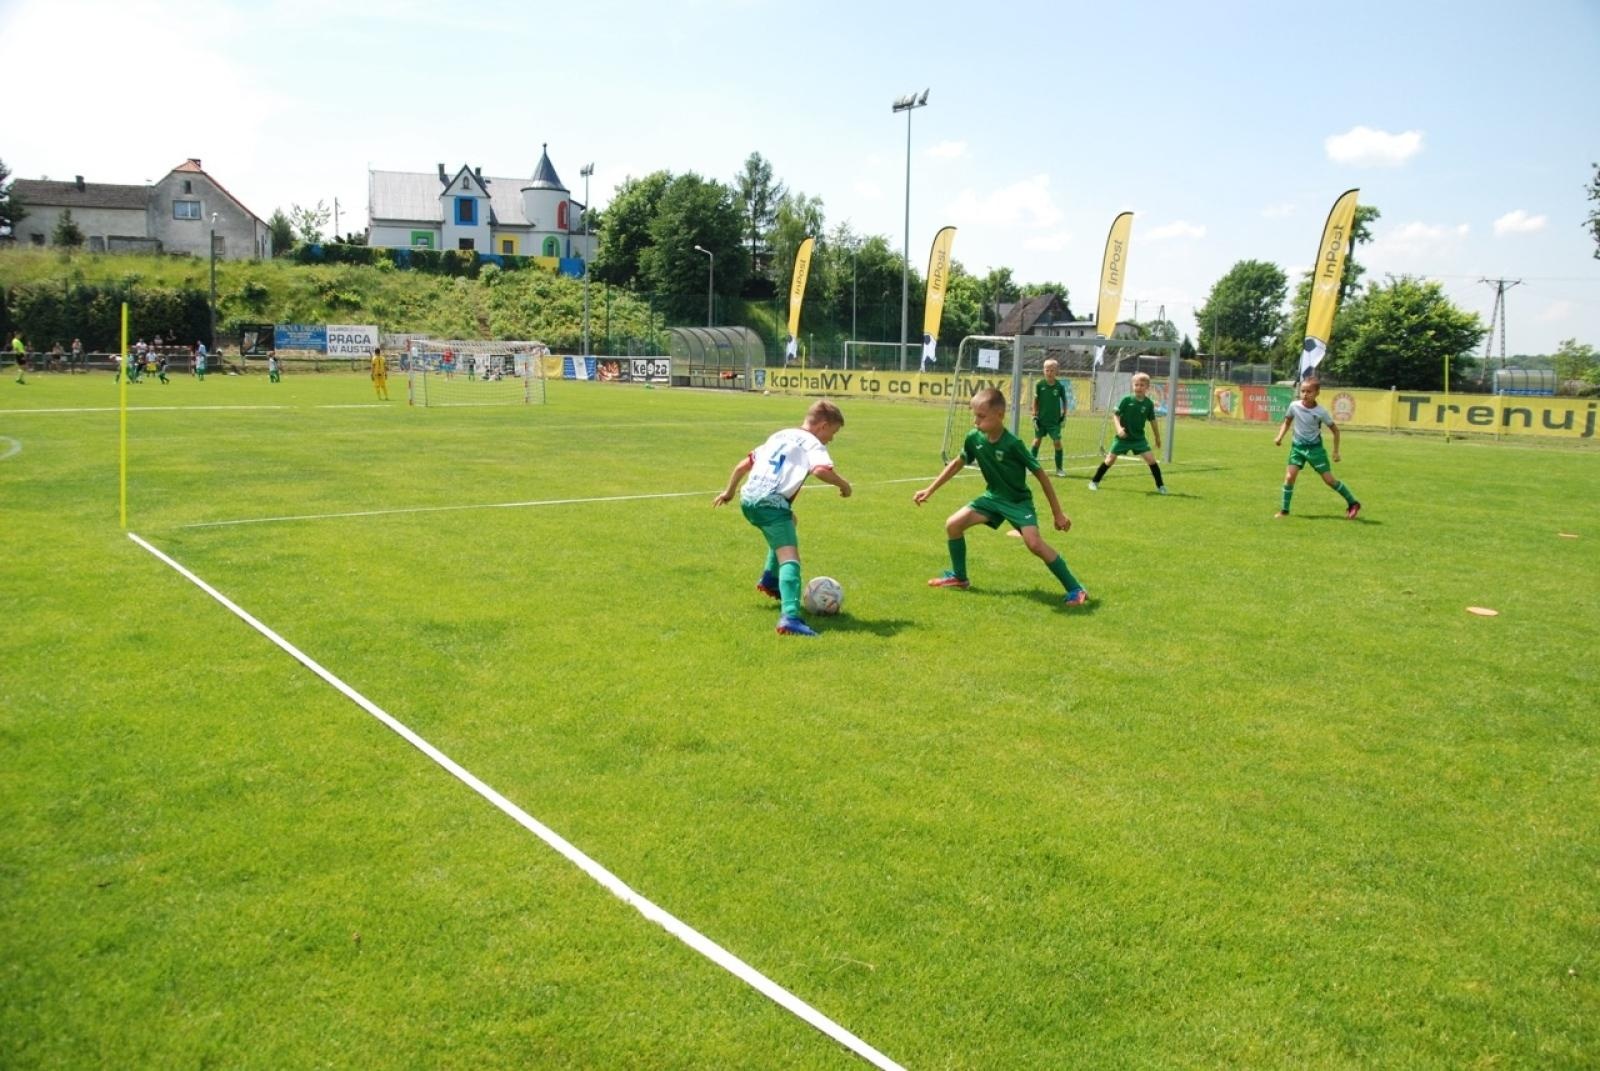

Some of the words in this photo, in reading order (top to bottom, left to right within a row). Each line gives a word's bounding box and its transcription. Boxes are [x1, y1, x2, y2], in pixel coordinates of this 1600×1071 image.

[933, 250, 945, 290] InPost
[1108, 240, 1123, 285] InPost
[1323, 225, 1344, 278] InPost
[329, 334, 371, 344] PRACA
[770, 372, 852, 391] kochaMY
[860, 376, 880, 392] to
[888, 379, 911, 394] co
[1397, 395, 1597, 438] Trenuj
[768, 443, 787, 475] 4
